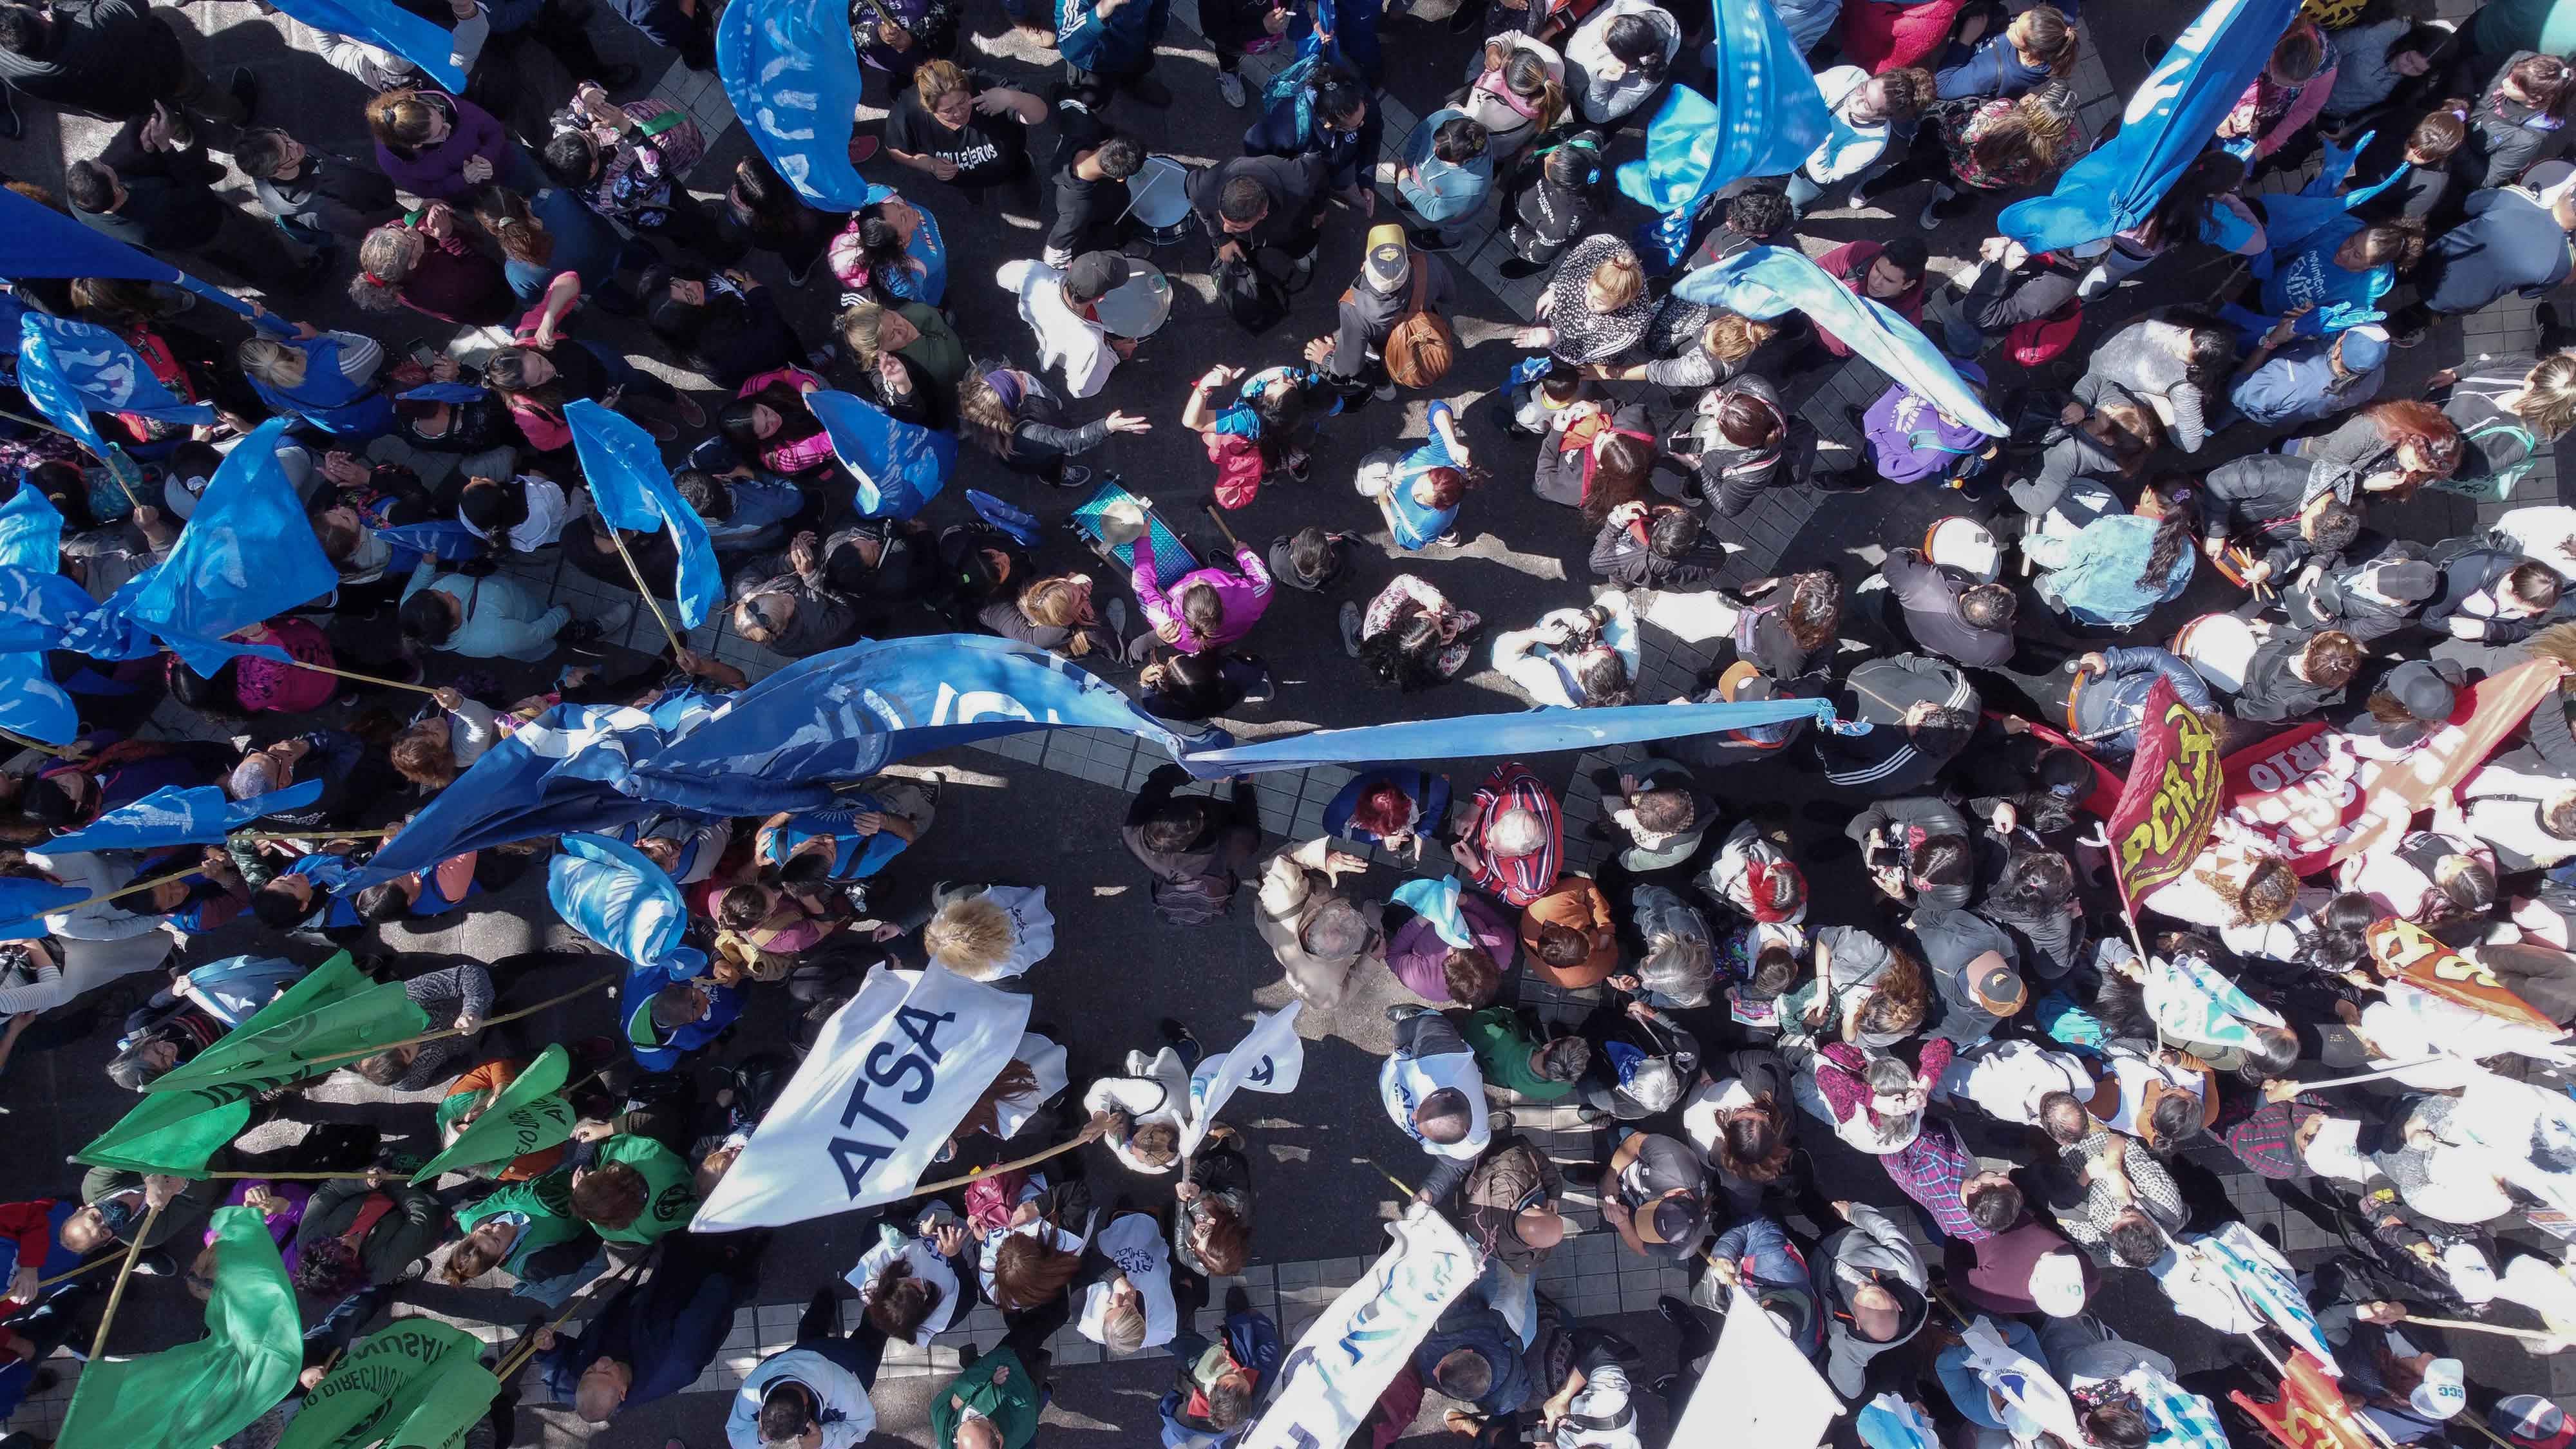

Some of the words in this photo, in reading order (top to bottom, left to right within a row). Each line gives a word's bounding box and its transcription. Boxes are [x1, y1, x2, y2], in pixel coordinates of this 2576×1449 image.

[1536, 178, 1555, 225] BALENCIAGA
[827, 1005, 956, 1202] ATSA
[2438, 1386, 2464, 1399] CCC
